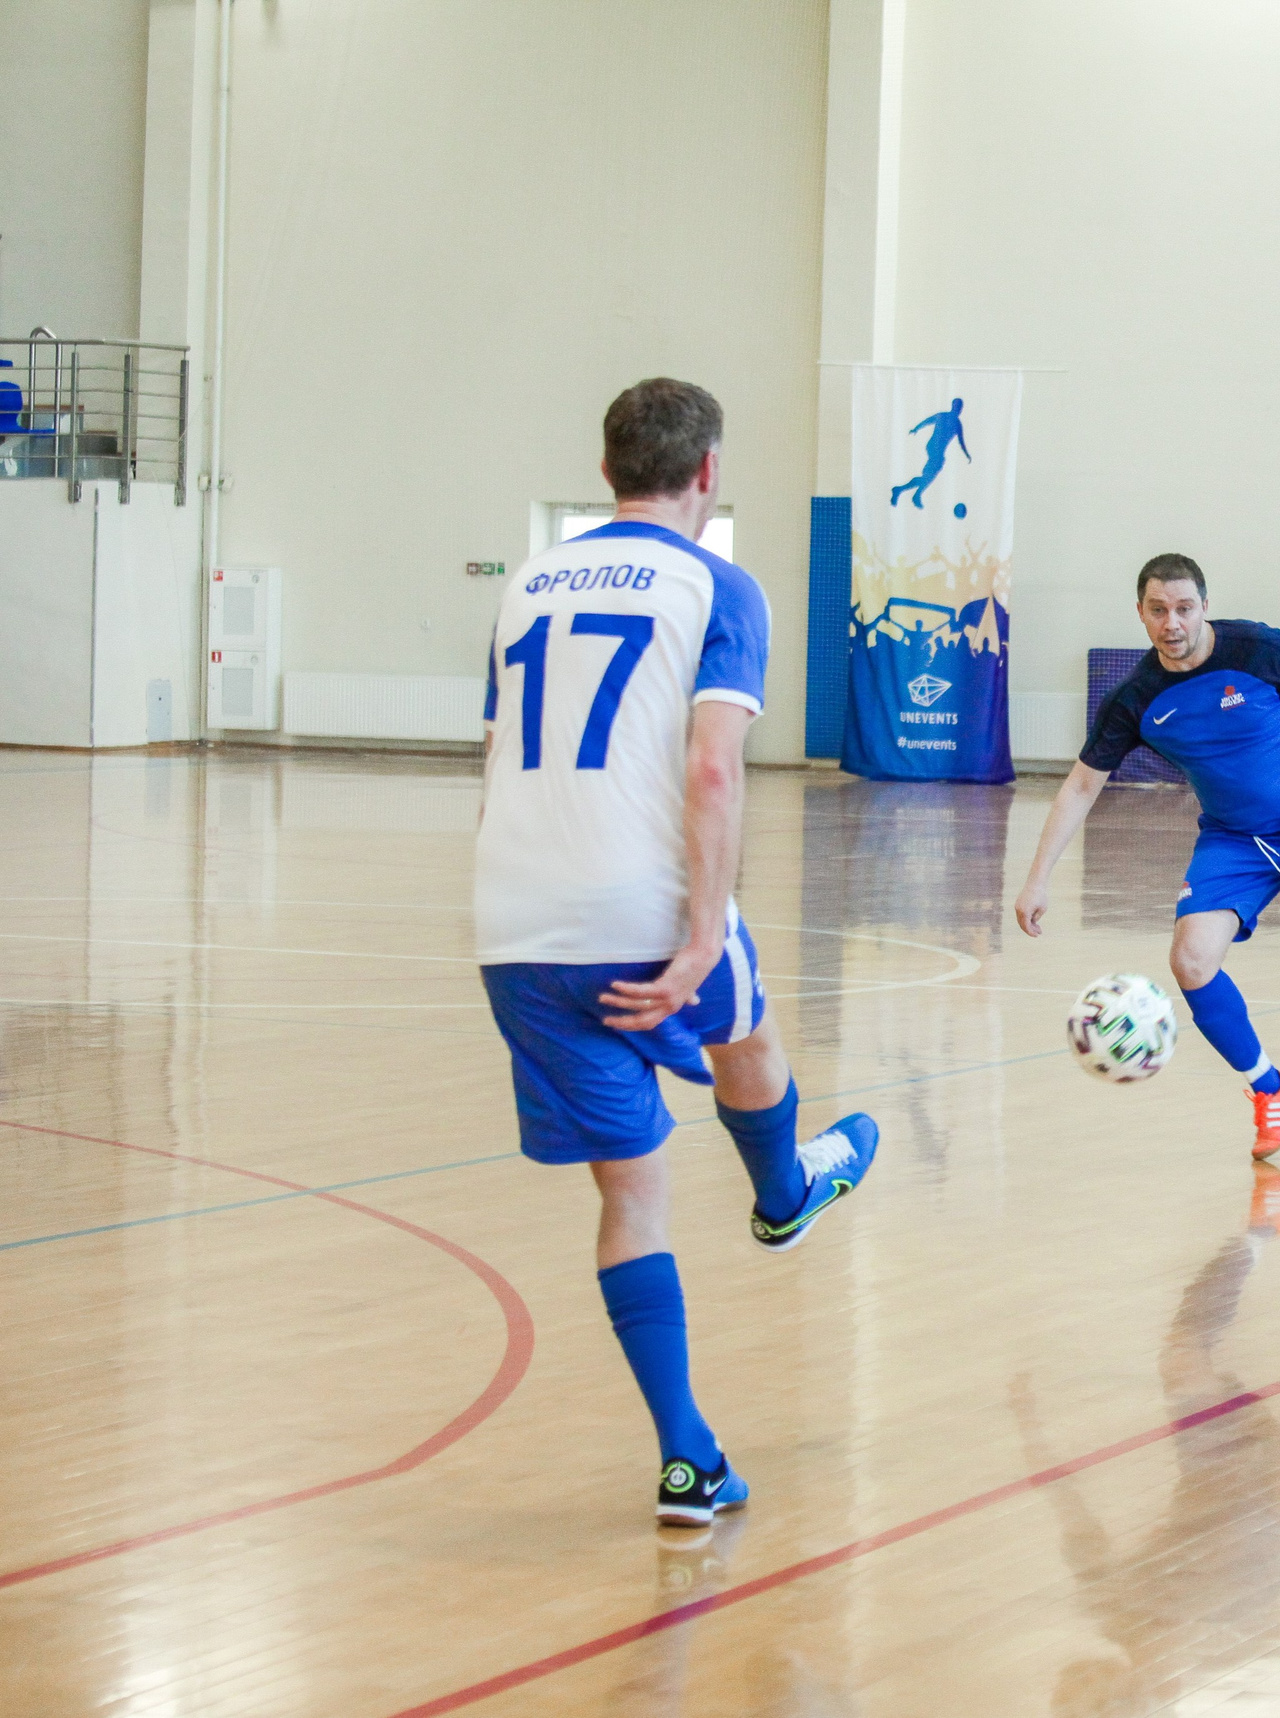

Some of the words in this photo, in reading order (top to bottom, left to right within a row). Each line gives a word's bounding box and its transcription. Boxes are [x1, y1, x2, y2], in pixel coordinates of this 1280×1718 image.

[525, 564, 656, 595] ФРОЛОВ
[505, 613, 655, 771] 17
[900, 711, 959, 726] UNEVENTS
[897, 736, 957, 751] #unevents
